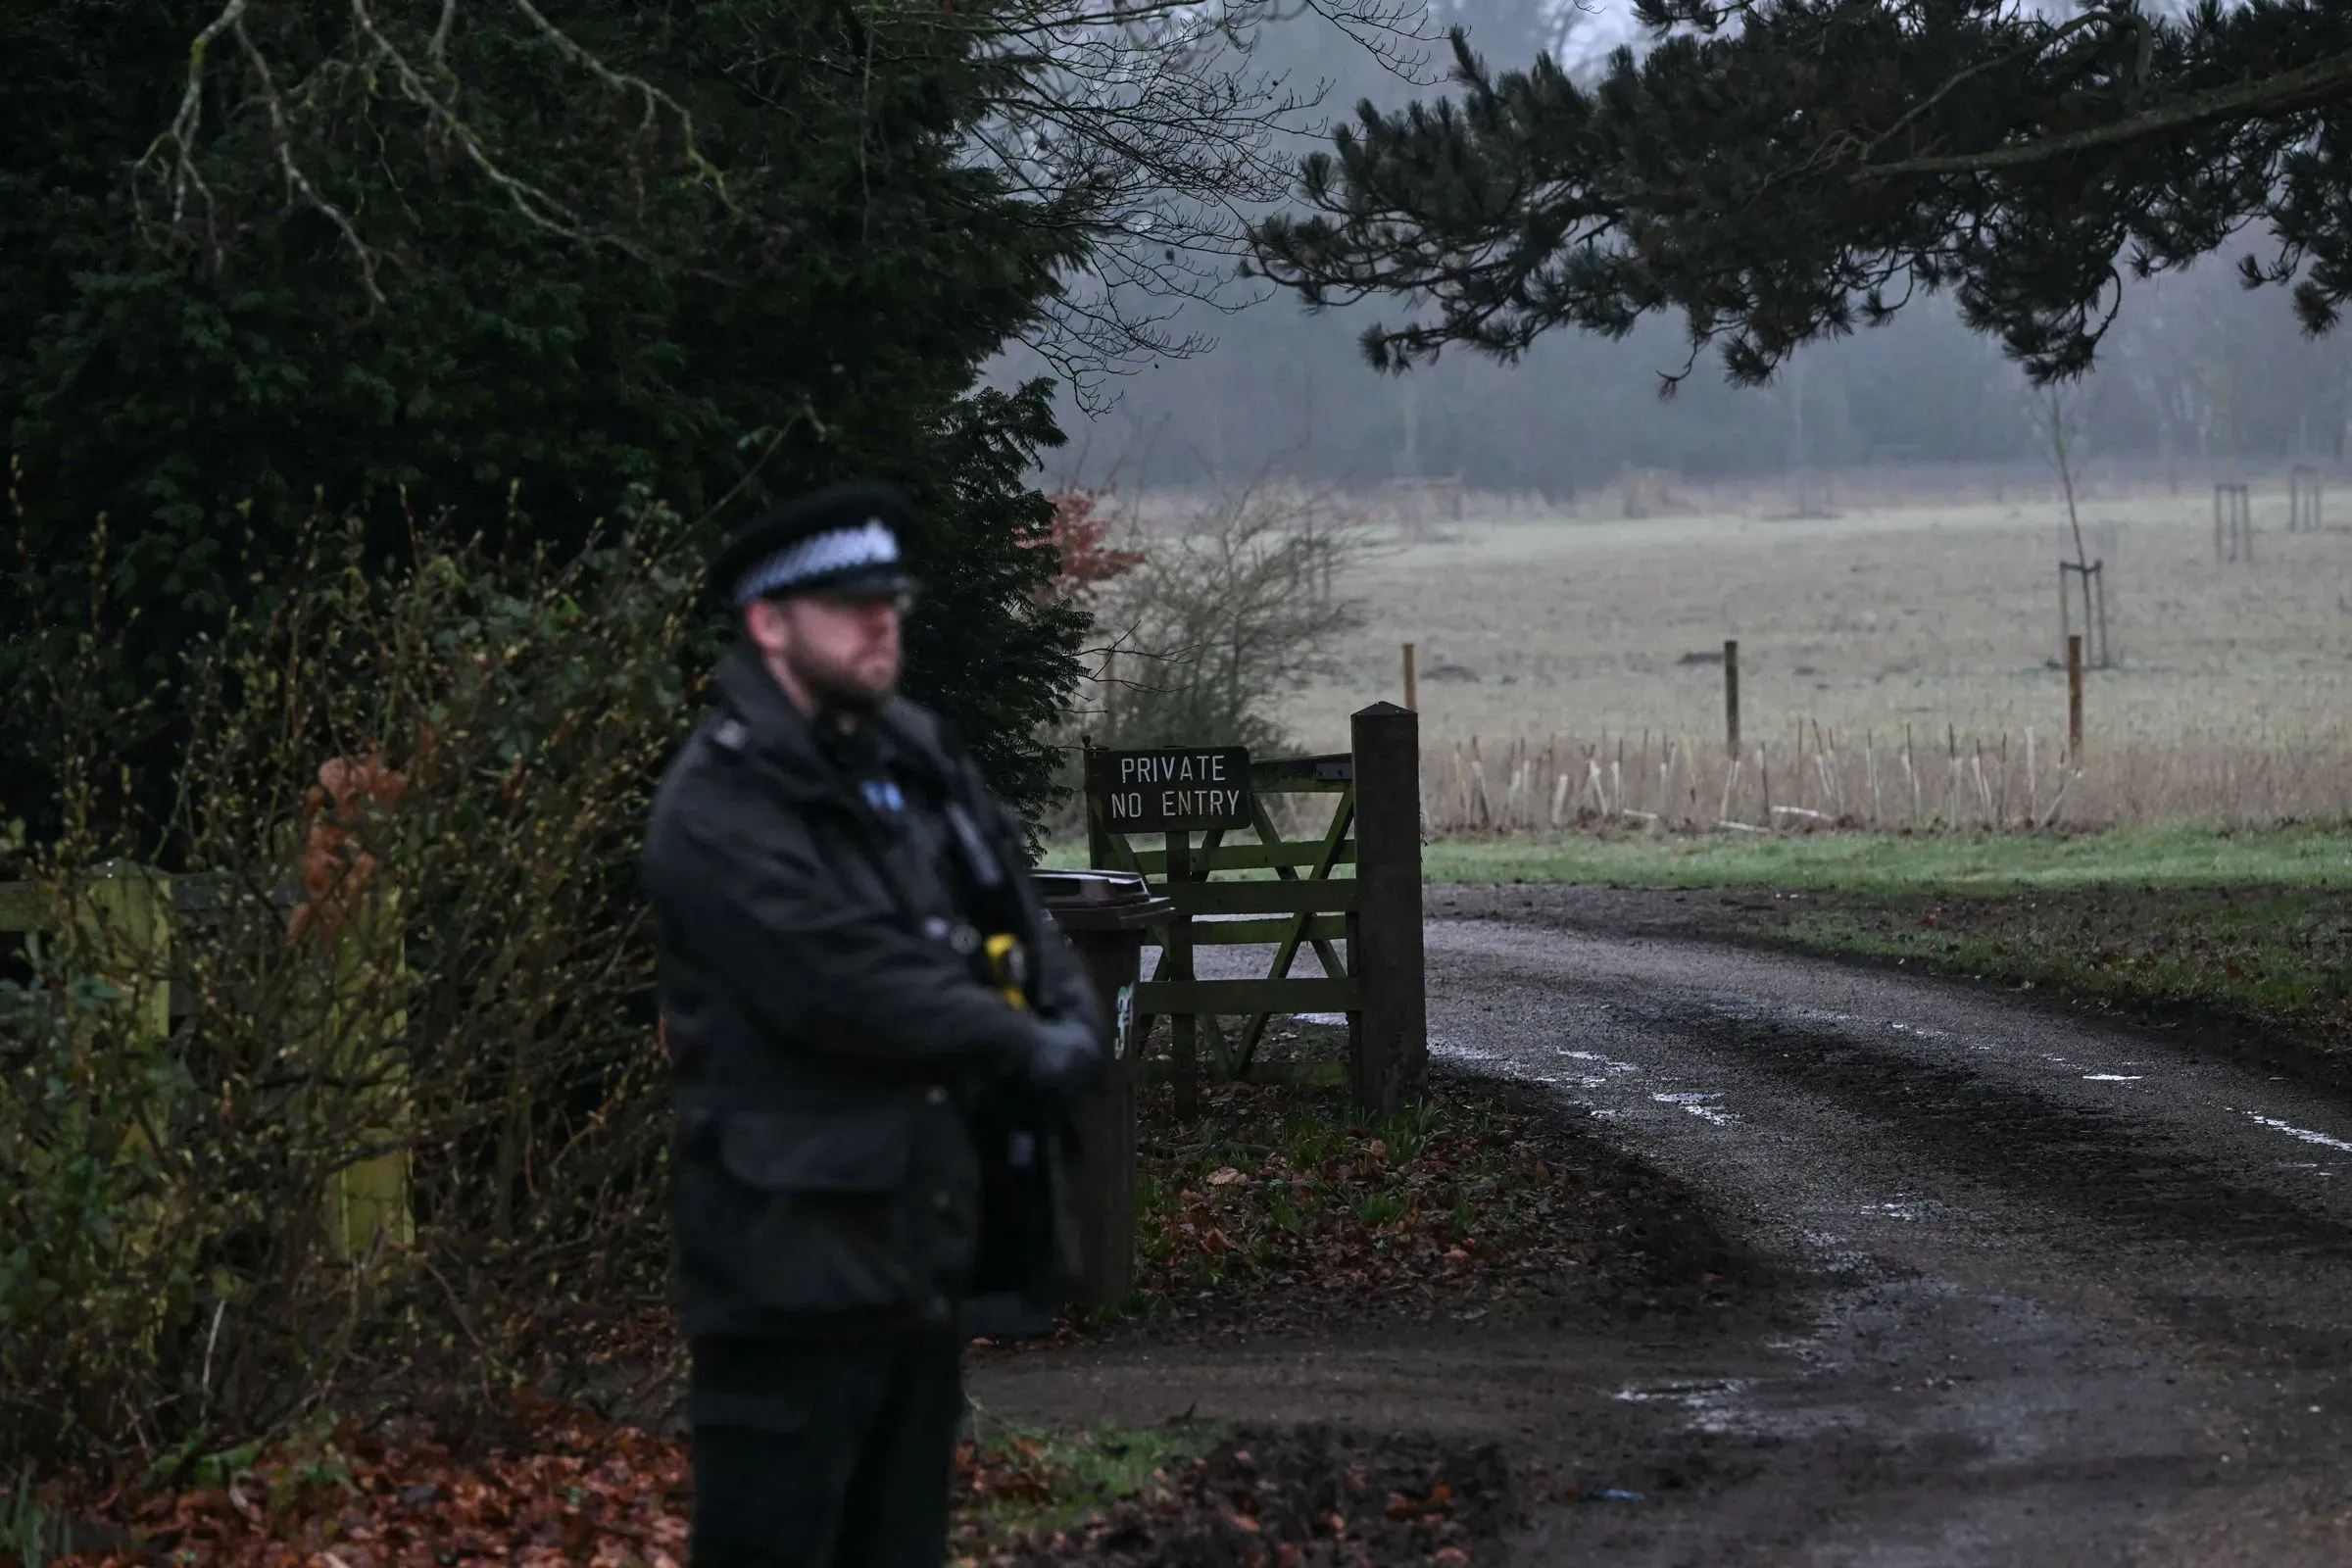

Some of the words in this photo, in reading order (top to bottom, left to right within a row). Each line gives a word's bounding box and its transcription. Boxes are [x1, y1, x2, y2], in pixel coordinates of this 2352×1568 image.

[1121, 755, 1226, 784] PRIVATE
[1111, 792, 1142, 818] NO
[1162, 789, 1240, 816] ENTRY
